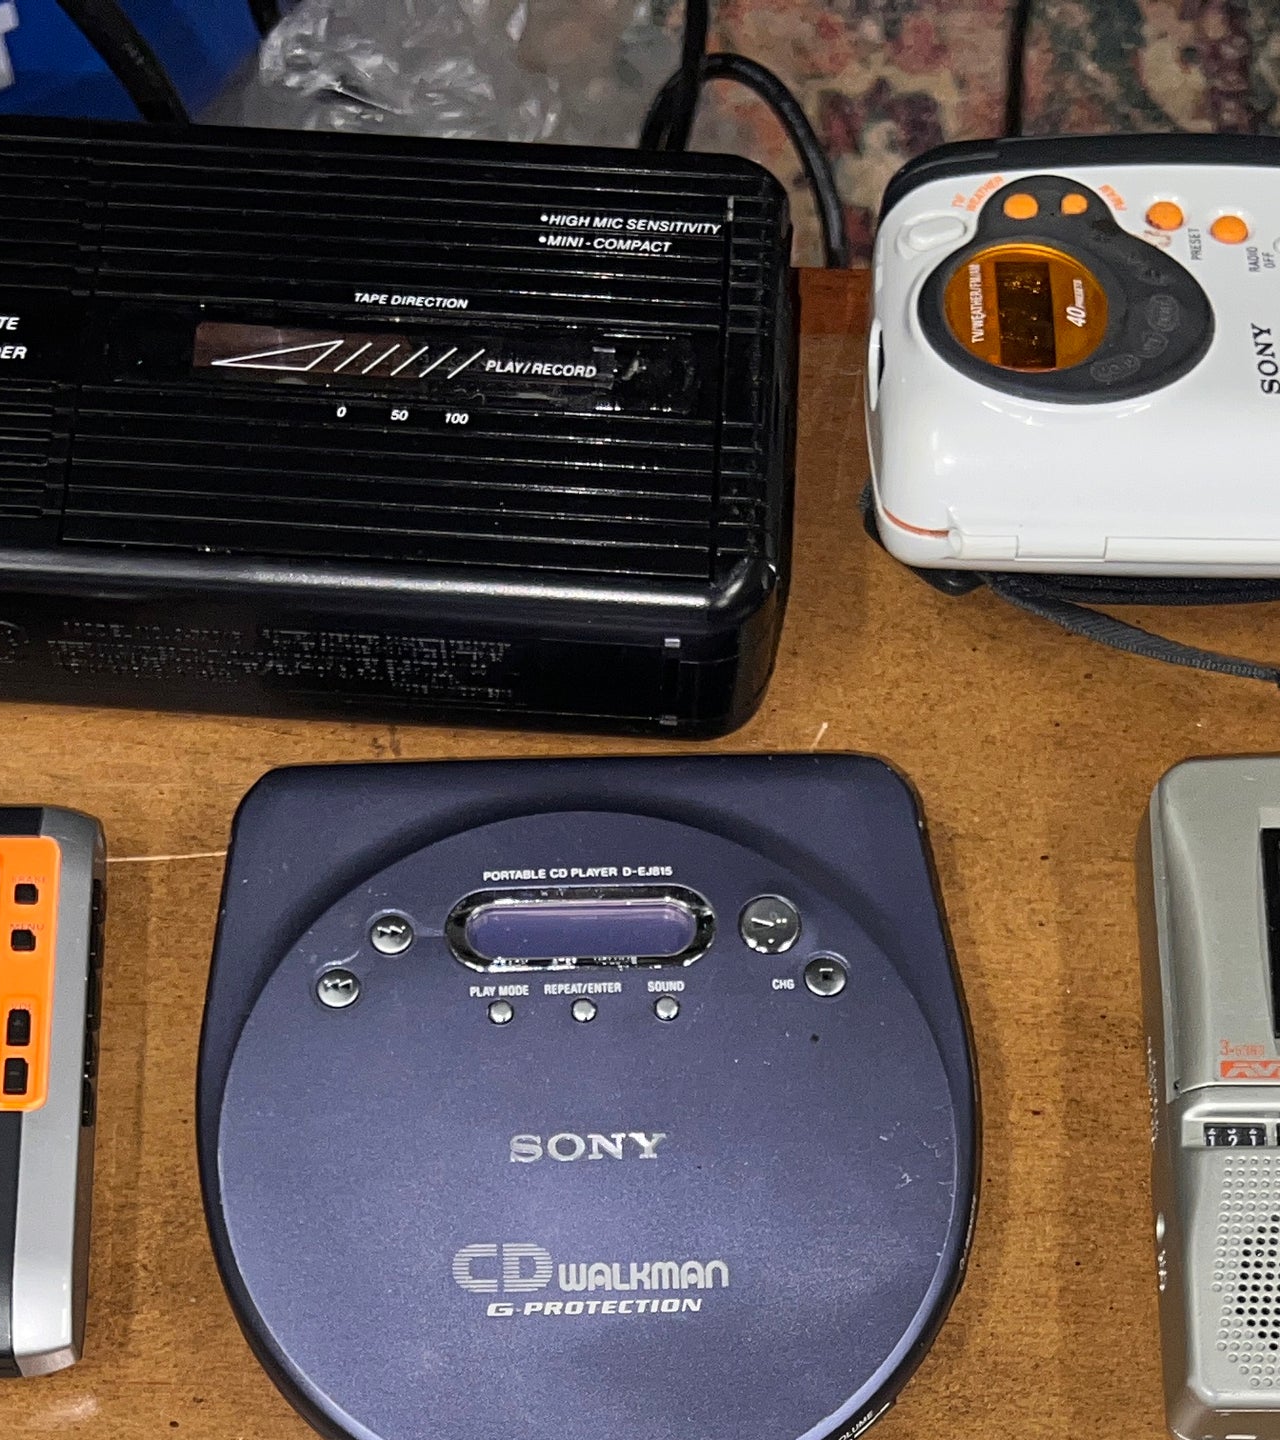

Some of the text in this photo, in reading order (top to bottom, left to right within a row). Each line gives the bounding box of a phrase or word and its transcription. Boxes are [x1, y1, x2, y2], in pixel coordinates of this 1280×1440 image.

[549, 214, 721, 235] HIGH MIC SENSITIVITY
[1188, 228, 1202, 261] PRESET
[1247, 246, 1260, 273] RADIO
[1263, 252, 1276, 269] OFF
[354, 292, 468, 310] TAPE DIRECTION
[485, 359, 597, 379] PLAY/RECORD
[336, 406, 469, 425] 0 50 100
[483, 868, 546, 883] PORTABLE
[549, 867, 567, 880] CD
[570, 866, 618, 880] PLAYER
[470, 983, 530, 998] PLAY MODE
[544, 981, 622, 996] REPEAT/ENTER
[647, 979, 685, 993] SOUND
[772, 978, 795, 991] CHG
[509, 1132, 667, 1163] SONY
[452, 1243, 730, 1293] CD WALKMAN
[486, 1298, 704, 1317] G-PROTECTION
